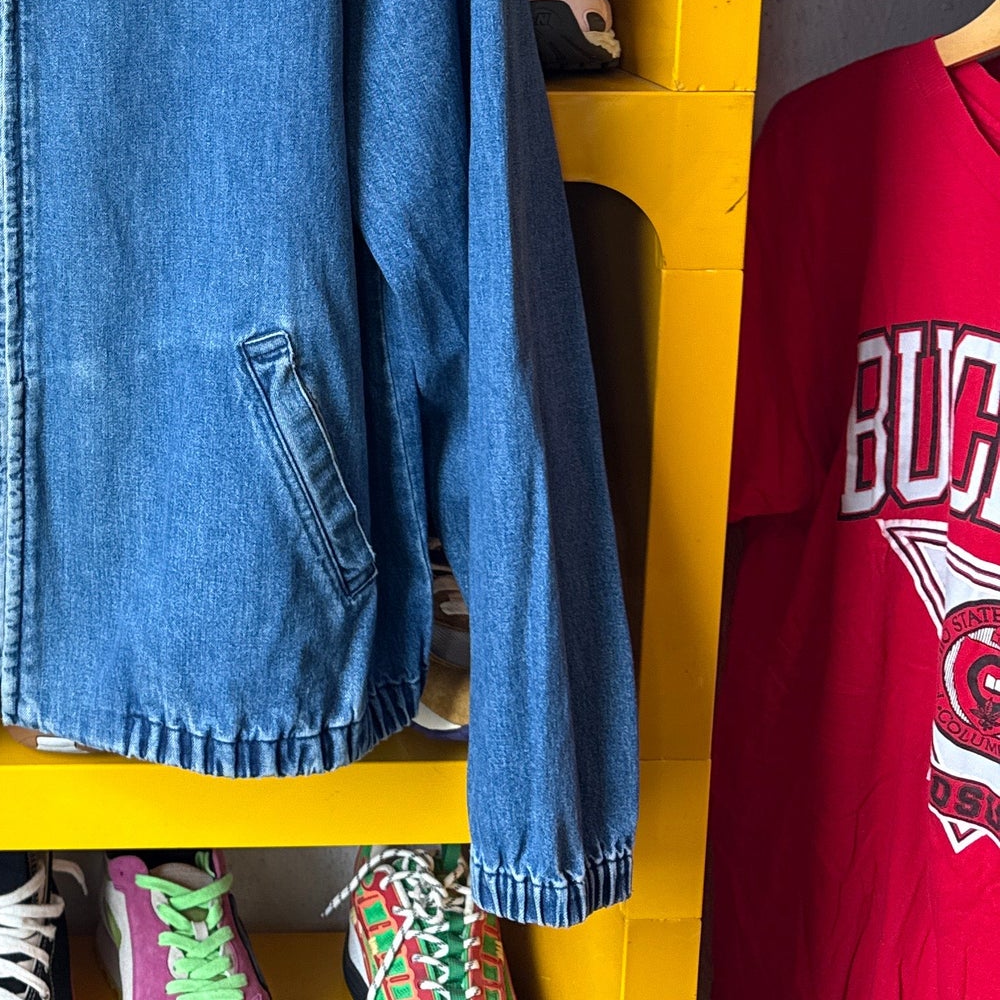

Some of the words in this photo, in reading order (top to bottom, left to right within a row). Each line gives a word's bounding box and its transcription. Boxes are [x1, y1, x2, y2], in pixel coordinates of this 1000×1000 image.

[837, 320, 1000, 536] BUC
[951, 606, 1000, 632] STATE
[937, 709, 1000, 757] COLUM
